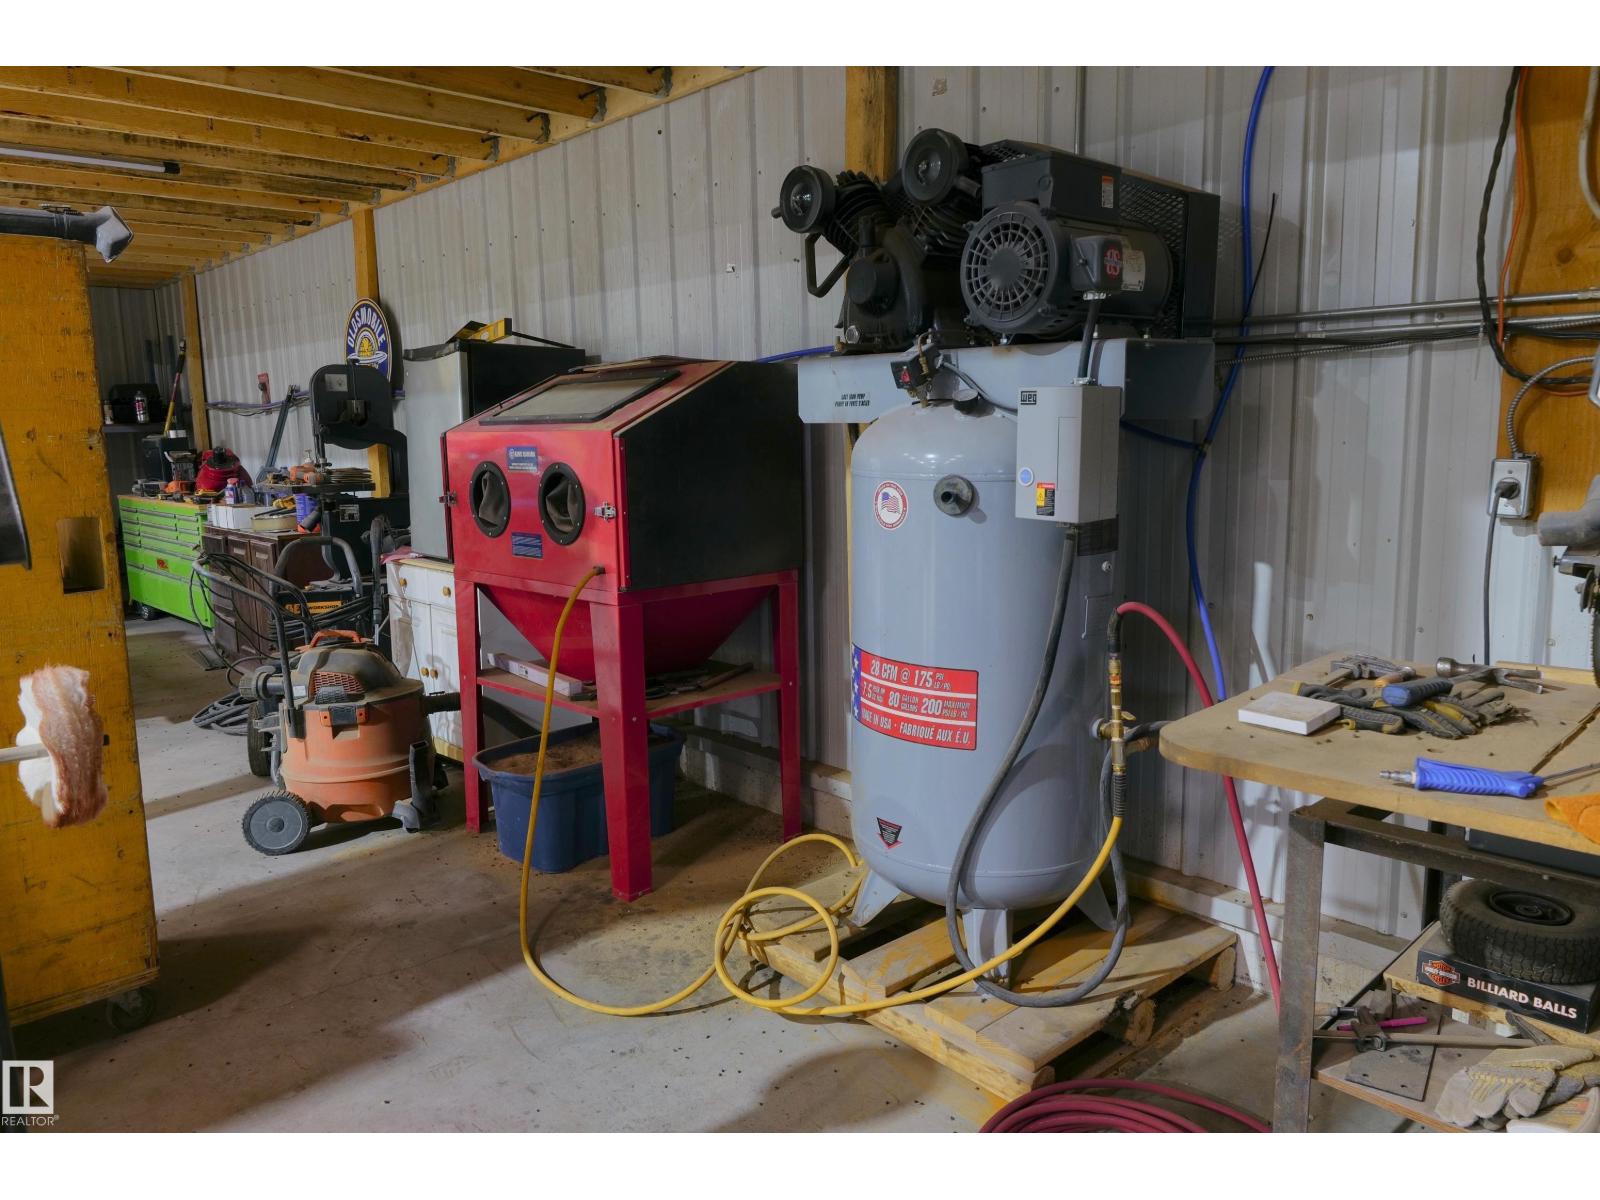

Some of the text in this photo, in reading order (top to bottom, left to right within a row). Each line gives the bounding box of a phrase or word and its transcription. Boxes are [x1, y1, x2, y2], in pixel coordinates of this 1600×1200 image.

[347, 307, 386, 349] OLDSMOBILE
[870, 660, 933, 688] 28 CFM @ 175
[863, 681, 872, 698] 7.5
[888, 691, 900, 707] 80
[921, 698, 942, 716] 200
[873, 713, 879, 725] IN
[880, 716, 892, 729] USA
[900, 721, 935, 739] FABRIQUÉ
[936, 728, 953, 742] AUX
[1467, 976, 1577, 1019] BILLIARD BALLS
